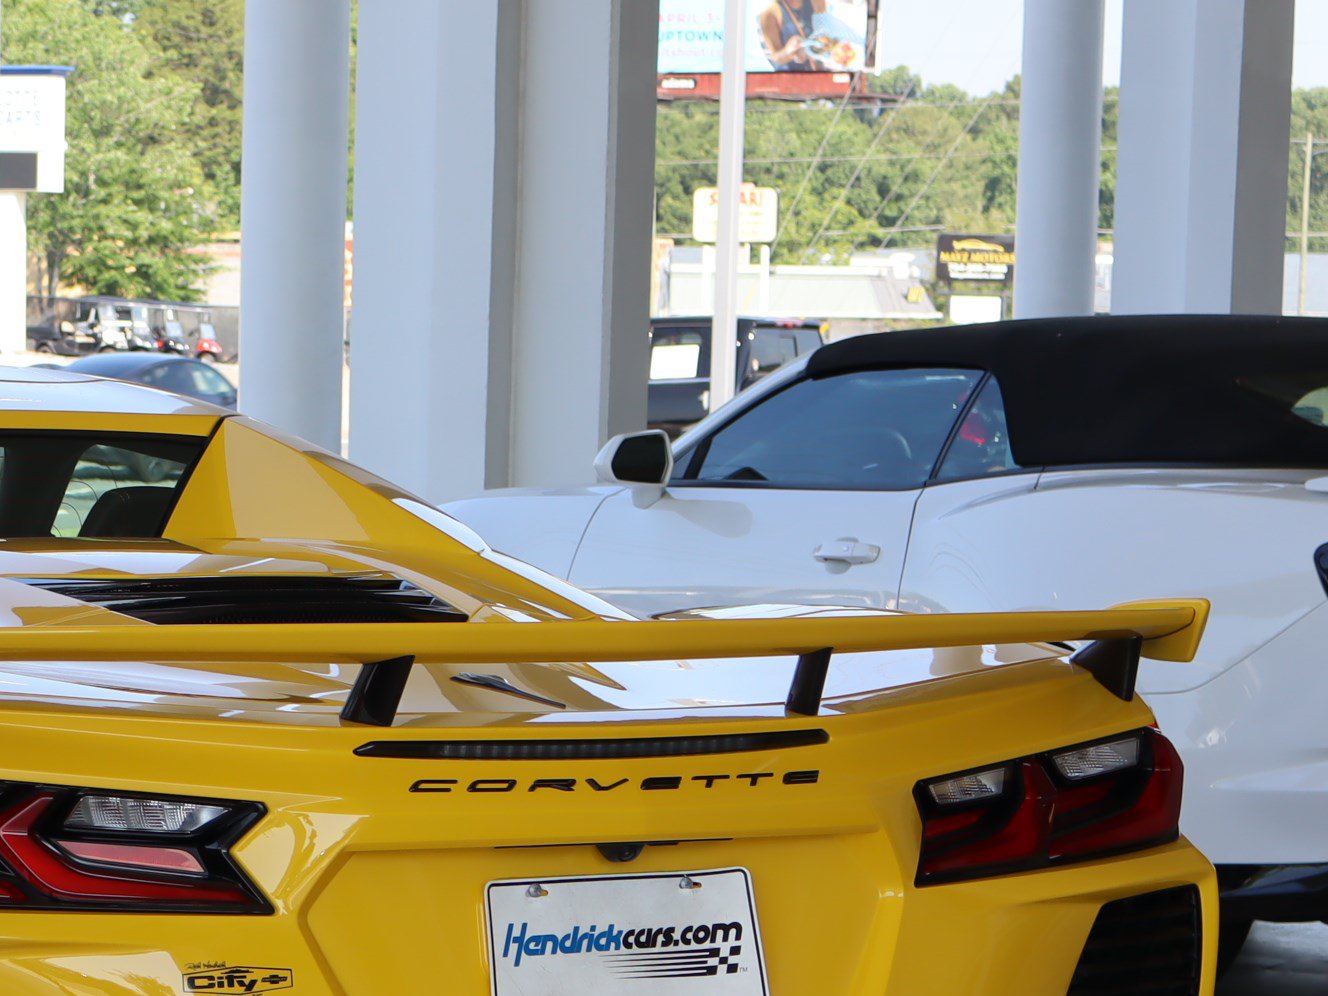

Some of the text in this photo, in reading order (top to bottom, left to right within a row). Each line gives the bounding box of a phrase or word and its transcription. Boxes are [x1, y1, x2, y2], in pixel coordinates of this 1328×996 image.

[408, 769, 820, 793] CORVETTE
[502, 921, 743, 967] Hendrickcars.com
[187, 975, 258, 992] City
